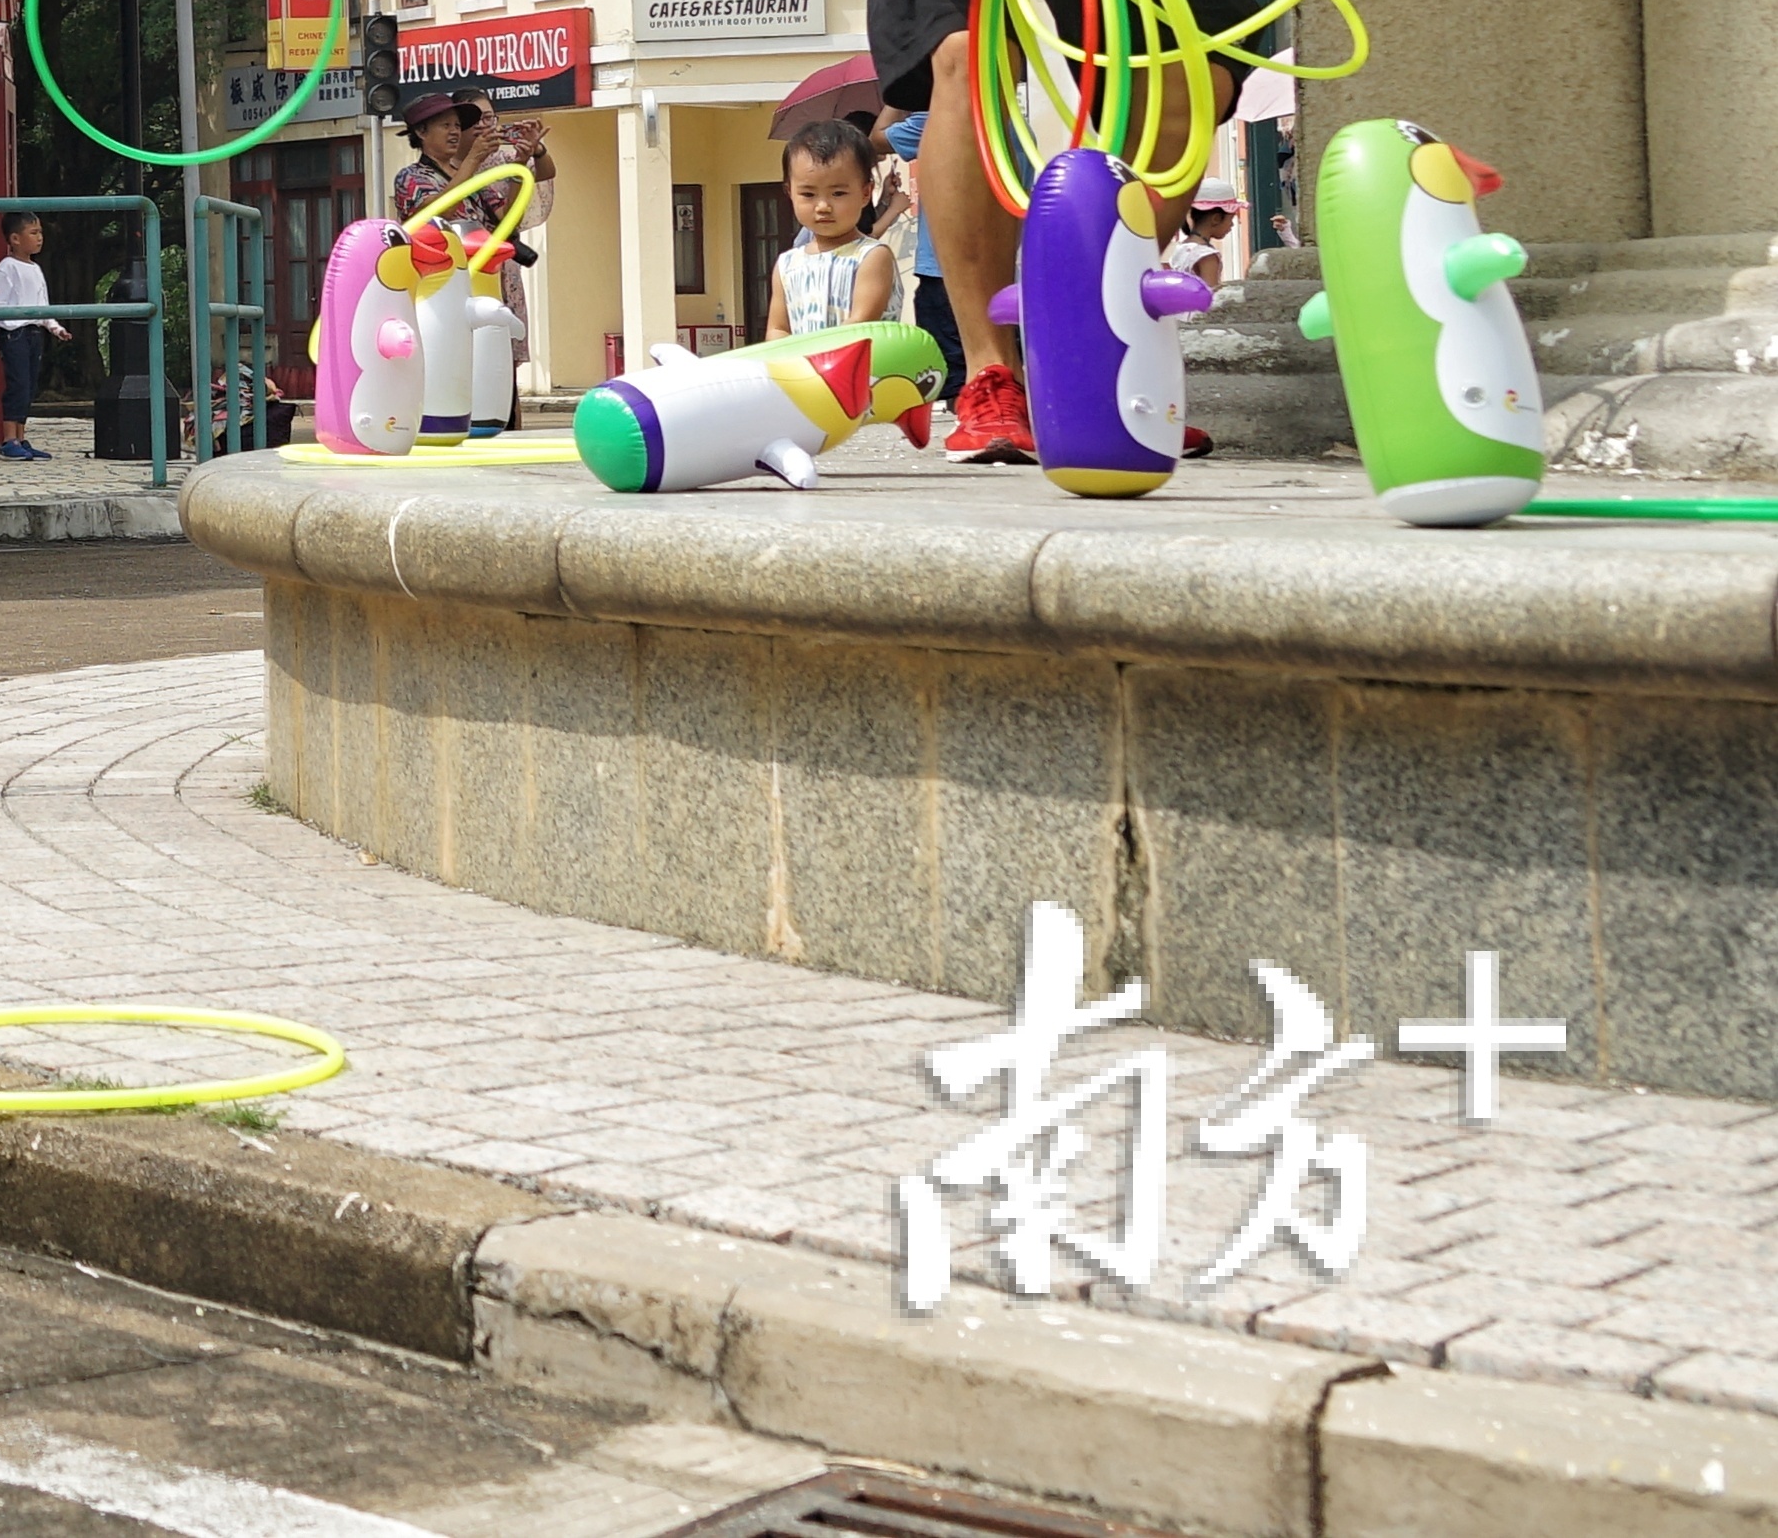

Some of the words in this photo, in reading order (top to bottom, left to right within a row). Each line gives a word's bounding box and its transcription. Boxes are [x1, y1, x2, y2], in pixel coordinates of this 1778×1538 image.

[649, 19, 696, 29] UPSTAIRS
[698, 18, 724, 28] WITH
[726, 17, 752, 26] ROOF
[755, 16, 774, 26] TOP
[777, 15, 808, 25] VIEWS
[398, 39, 471, 84] TATTOO
[474, 26, 568, 77] PIERCING
[496, 83, 540, 100] PIERCING
